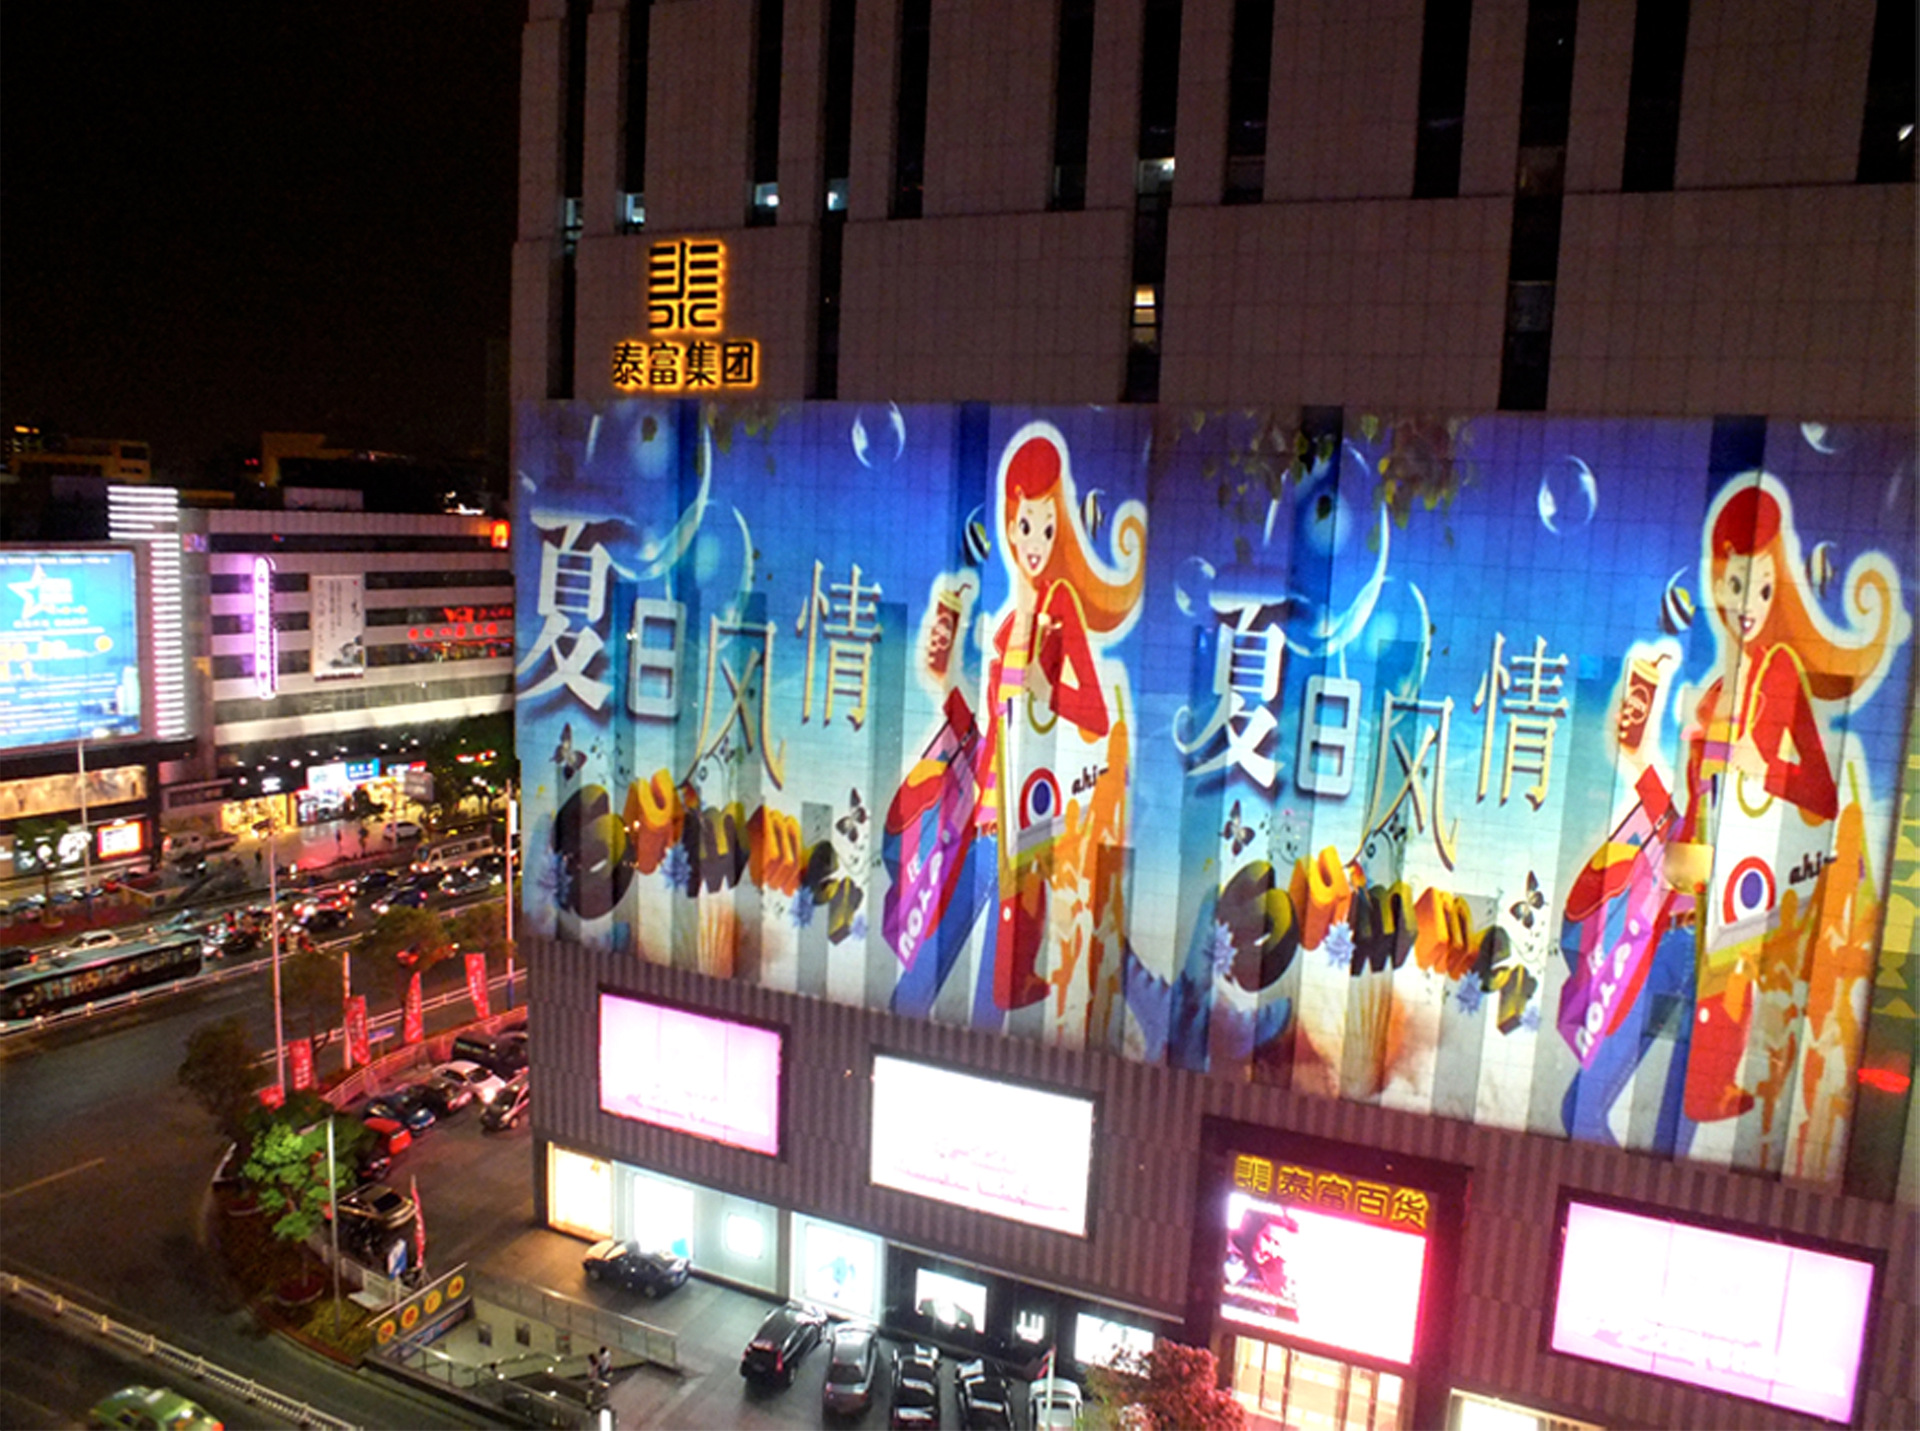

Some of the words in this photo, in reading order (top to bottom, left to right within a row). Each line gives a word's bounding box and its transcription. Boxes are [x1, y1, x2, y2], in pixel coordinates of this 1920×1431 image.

[613, 340, 757, 389] 泰富集团
[1277, 1164, 1430, 1230] 泰富百货
